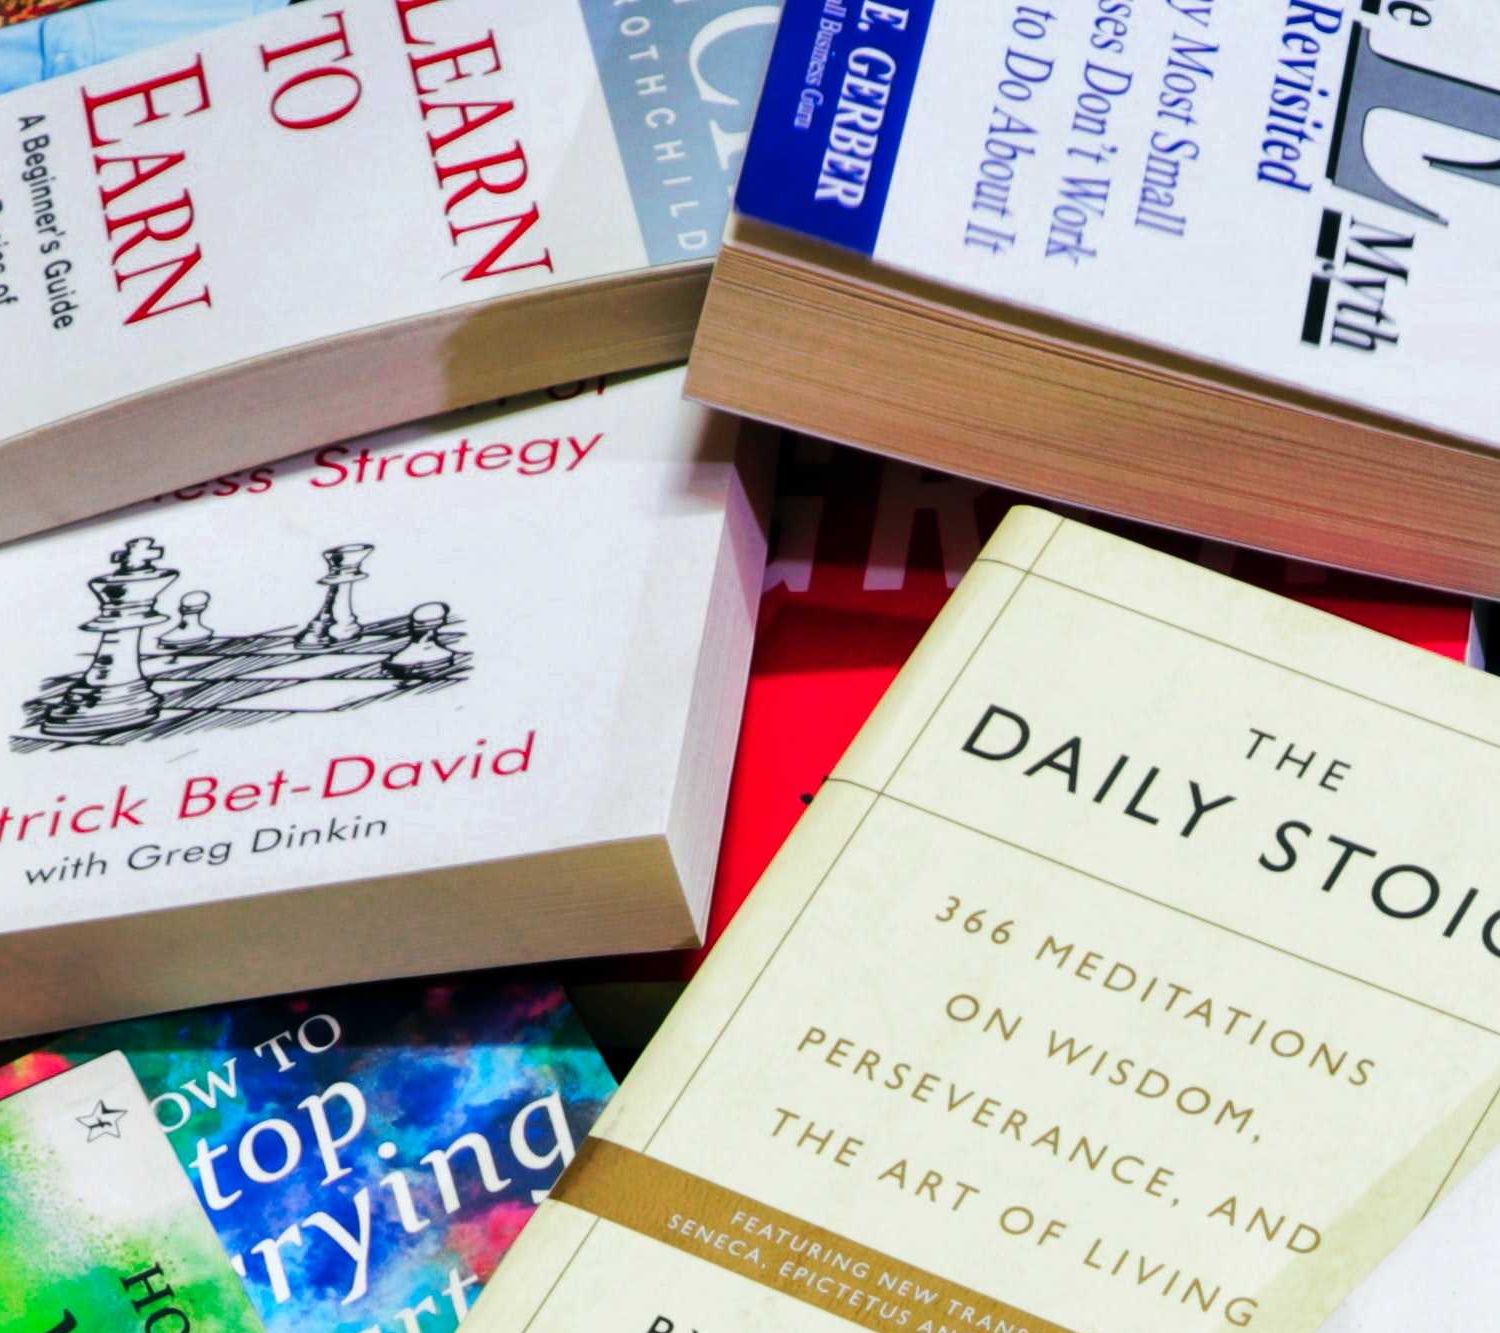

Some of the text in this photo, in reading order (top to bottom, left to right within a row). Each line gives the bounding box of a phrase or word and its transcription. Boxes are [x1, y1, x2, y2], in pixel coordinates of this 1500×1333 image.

[260, 11, 362, 129] TO
[82, 54, 214, 326] EARN
[1331, 215, 1416, 359] Myth
[308, 428, 604, 490] Strategy
[177, 730, 535, 819] Bet-David
[961, 703, 1236, 838] DAILY
[1245, 727, 1351, 792] THE
[24, 815, 387, 884] with Greg Dinkin
[935, 895, 1375, 1086] 366 MEDITATIONS
[944, 992, 1260, 1143] ON WISDOM,
[796, 1025, 1322, 1255] PERSEVERANCE, AND
[771, 1106, 1258, 1327] THE ART OF LIVING
